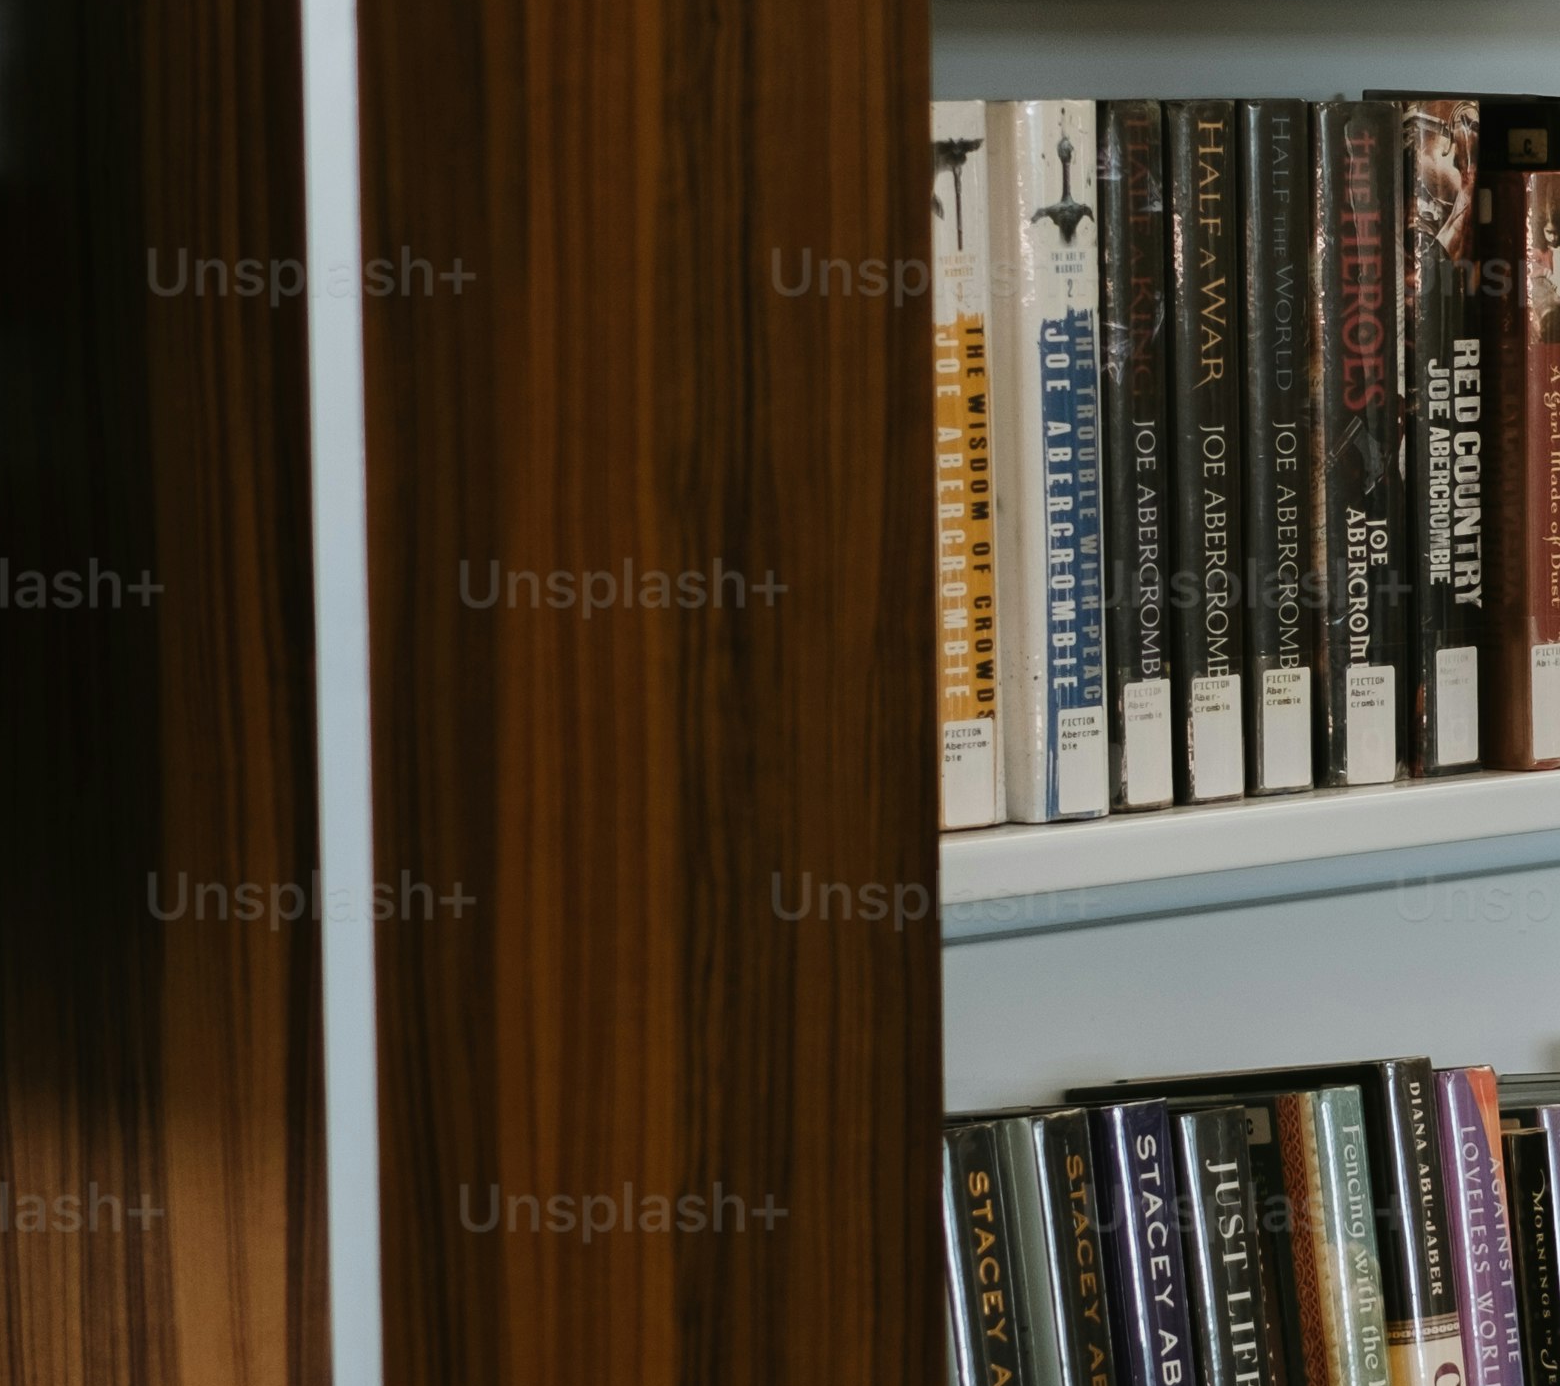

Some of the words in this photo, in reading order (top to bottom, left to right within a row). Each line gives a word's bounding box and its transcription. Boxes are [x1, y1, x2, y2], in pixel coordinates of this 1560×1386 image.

[1197, 121, 1224, 237] HALF
[1272, 117, 1291, 203] HALF
[1199, 249, 1217, 268] A
[1273, 217, 1287, 258] THE
[935, 328, 961, 397] JOE
[965, 327, 984, 379] THE
[1043, 327, 1071, 393] JOE
[1193, 277, 1226, 391] WAR
[1273, 265, 1294, 392] WORLD
[1453, 339, 1481, 424] RED
[1428, 358, 1450, 420] JOE
[967, 395, 989, 521] WISDOM
[1428, 426, 1451, 586] ABERCROMBIE
[937, 426, 969, 699] ABERCROMBIE
[972, 541, 992, 575] OF
[1046, 419, 1078, 690] ABERCROMBIE
[1453, 432, 1482, 609] COUNTRY
[974, 594, 996, 719] CROWDS
[1136, 1134, 1176, 1307] STACEY
[1205, 1158, 1248, 1271] JUST
[1342, 1125, 1366, 1237] Fencing
[1409, 1081, 1424, 1151] DIANA
[1418, 1163, 1444, 1297] ABU-JABER
[1460, 1126, 1491, 1275] LOVELESS
[967, 1170, 1008, 1344] STACEY
[1356, 1251, 1376, 1313] with
[1359, 1320, 1379, 1372] the
